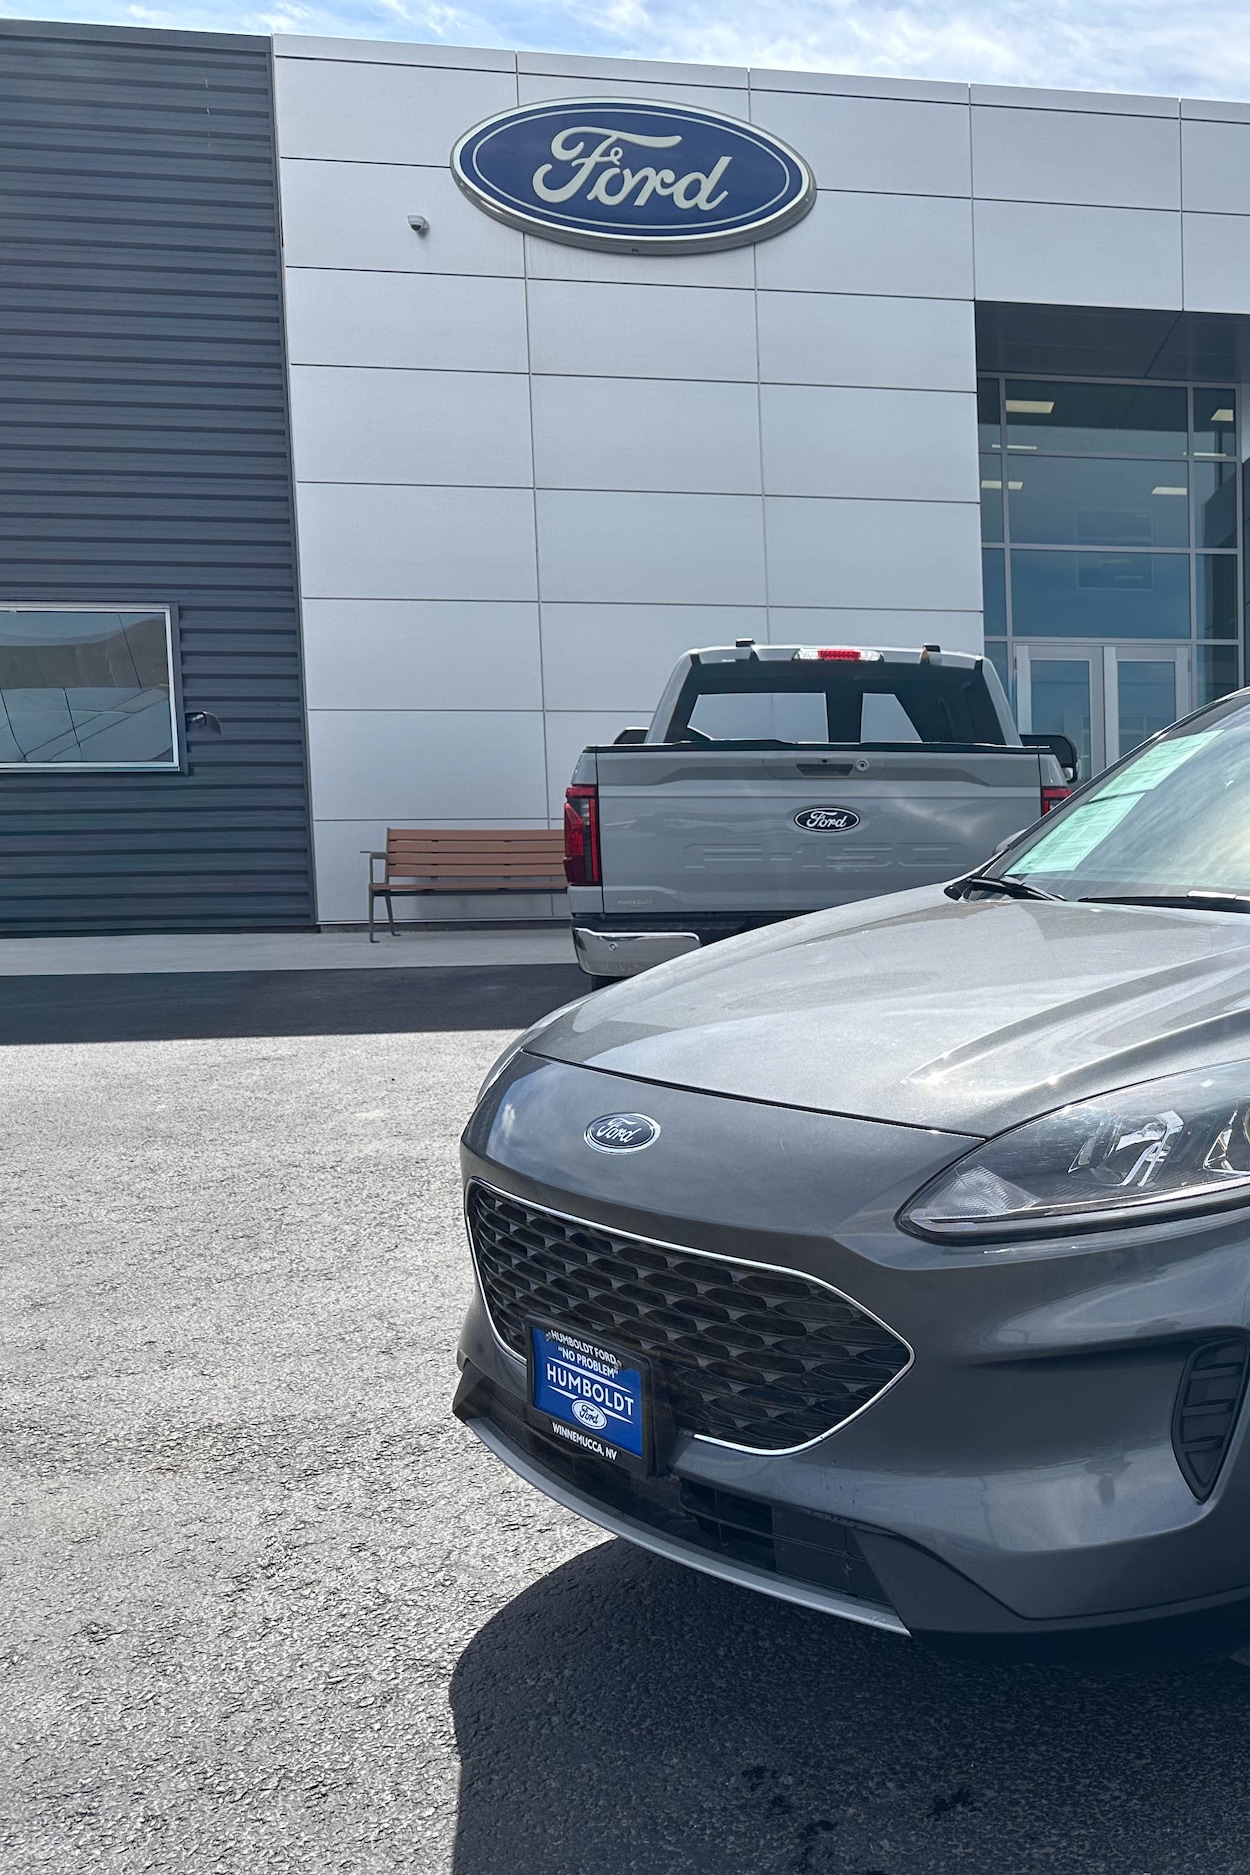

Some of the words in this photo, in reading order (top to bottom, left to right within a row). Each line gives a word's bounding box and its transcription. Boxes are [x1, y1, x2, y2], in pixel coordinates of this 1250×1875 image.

[532, 125, 733, 212] Ford
[806, 810, 848, 828] Ford
[596, 1117, 642, 1143] Ford
[551, 1330, 594, 1356] HUMBOLDT
[594, 1347, 616, 1365] FORD
[547, 1363, 635, 1416] HUMBOLDT
[579, 1404, 599, 1424] Ford
[552, 1422, 605, 1457] WINNEMUCCA,
[605, 1447, 618, 1461] NV
